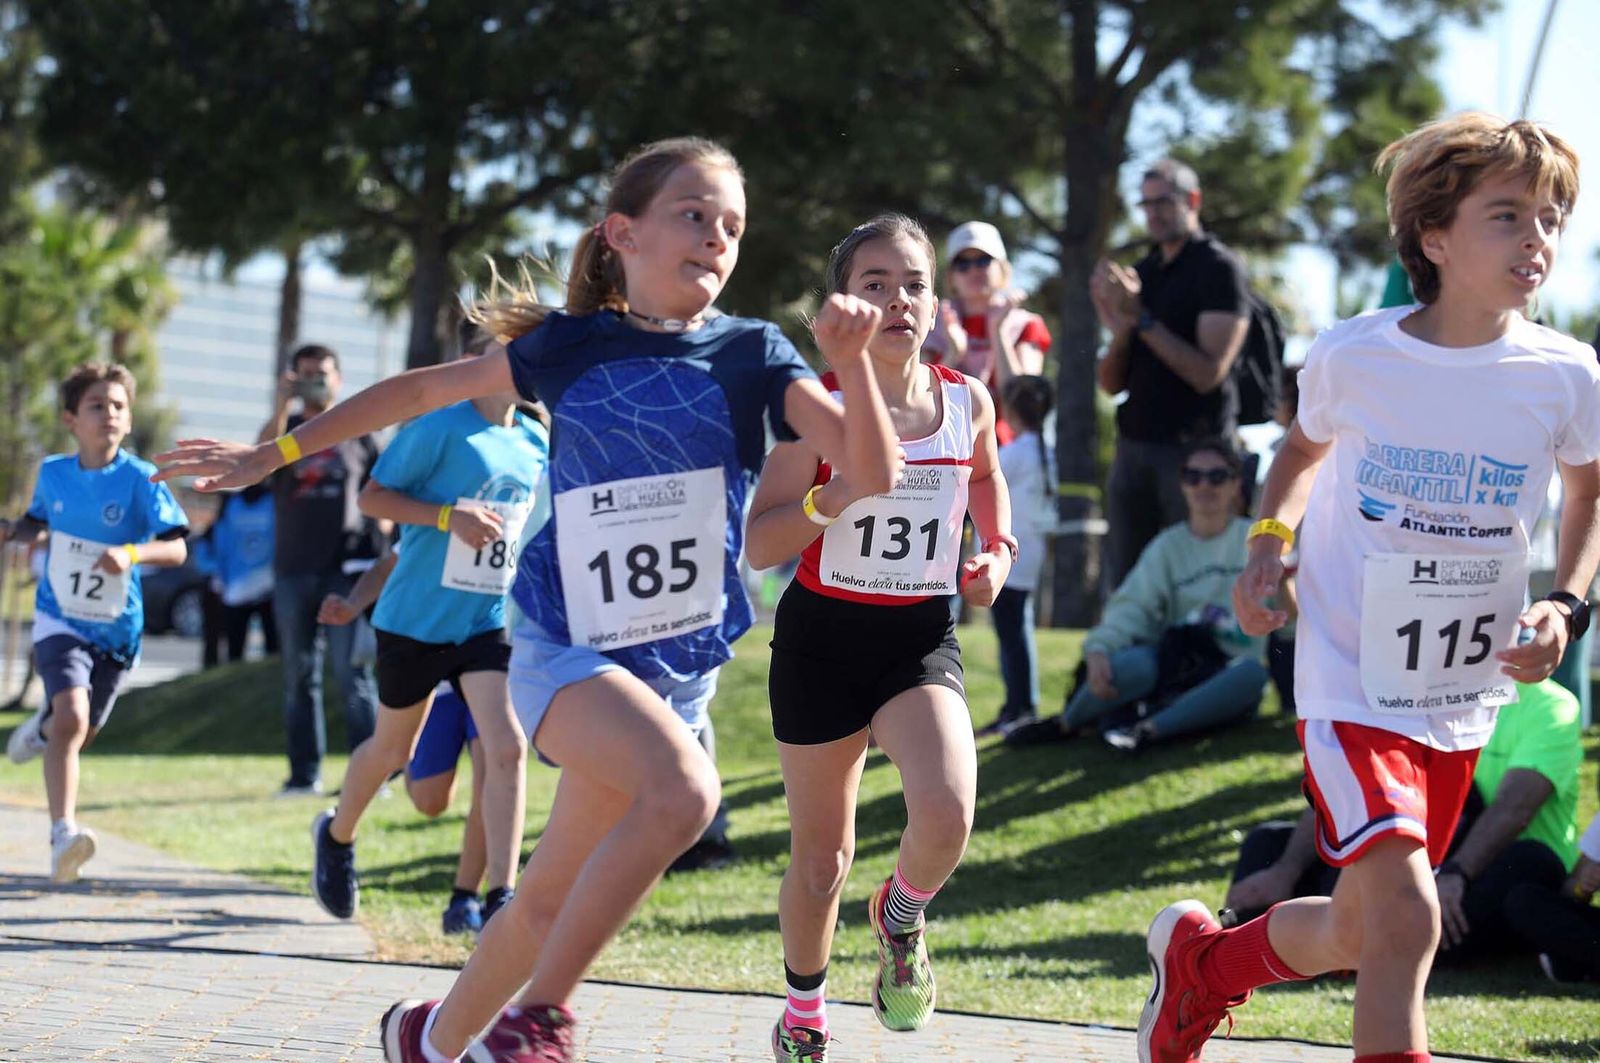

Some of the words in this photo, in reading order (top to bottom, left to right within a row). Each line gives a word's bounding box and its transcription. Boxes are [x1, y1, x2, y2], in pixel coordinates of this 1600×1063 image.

[907, 477, 940, 485] HUELVA
[1355, 458, 1464, 504] INFANTIL
[1479, 467, 1525, 488] kilos
[592, 489, 613, 510] H
[638, 489, 685, 503] HUELVA
[1475, 491, 1487, 504] x
[1493, 489, 1518, 507] km
[1404, 503, 1470, 525] Fundación
[853, 514, 940, 561] 131
[1400, 517, 1466, 538] ATLANTIC
[1468, 525, 1513, 539] COPPER
[587, 537, 698, 604] 185
[1413, 560, 1437, 578] H
[1441, 558, 1503, 569] DIPUTACIÓN
[1460, 568, 1500, 580] HUELVA
[70, 571, 105, 601] 12
[831, 571, 866, 587] Huelva
[868, 577, 894, 589] eleva
[895, 580, 911, 591] tus
[911, 581, 949, 591] sentidos.
[651, 622, 668, 634] tus
[1396, 613, 1496, 671] 115
[1377, 695, 1414, 709] Huelva
[1445, 693, 1462, 705] tus
[1463, 686, 1508, 702] sentidos.
